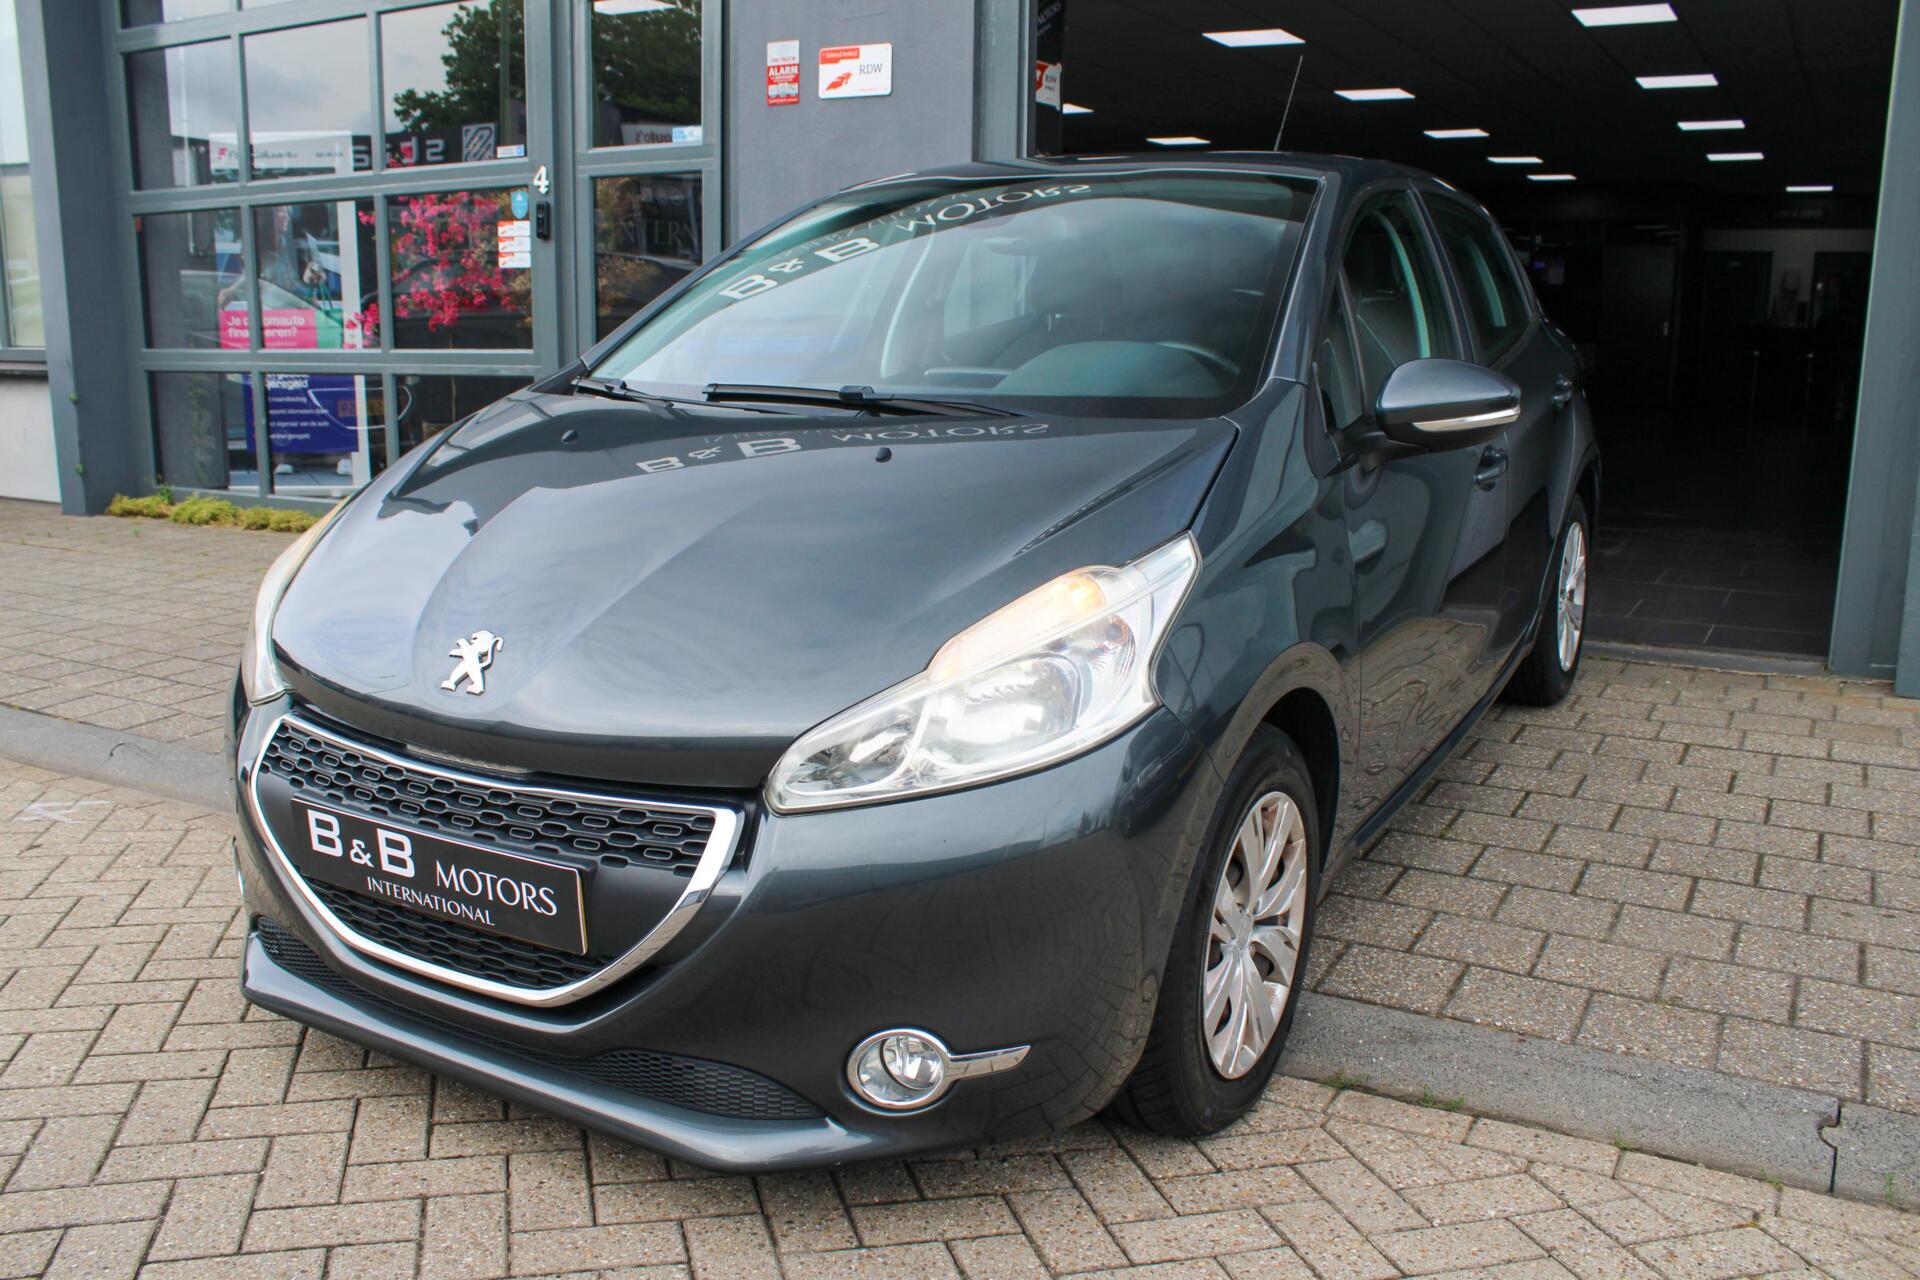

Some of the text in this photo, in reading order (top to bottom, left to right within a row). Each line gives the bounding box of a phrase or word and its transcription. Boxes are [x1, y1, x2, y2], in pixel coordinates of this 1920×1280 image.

[768, 66, 798, 77] ALARM
[859, 64, 883, 75] RDW
[533, 165, 549, 195] 4
[367, 876, 495, 926] INTERNATIONAL
[436, 860, 558, 916] MOTORS
